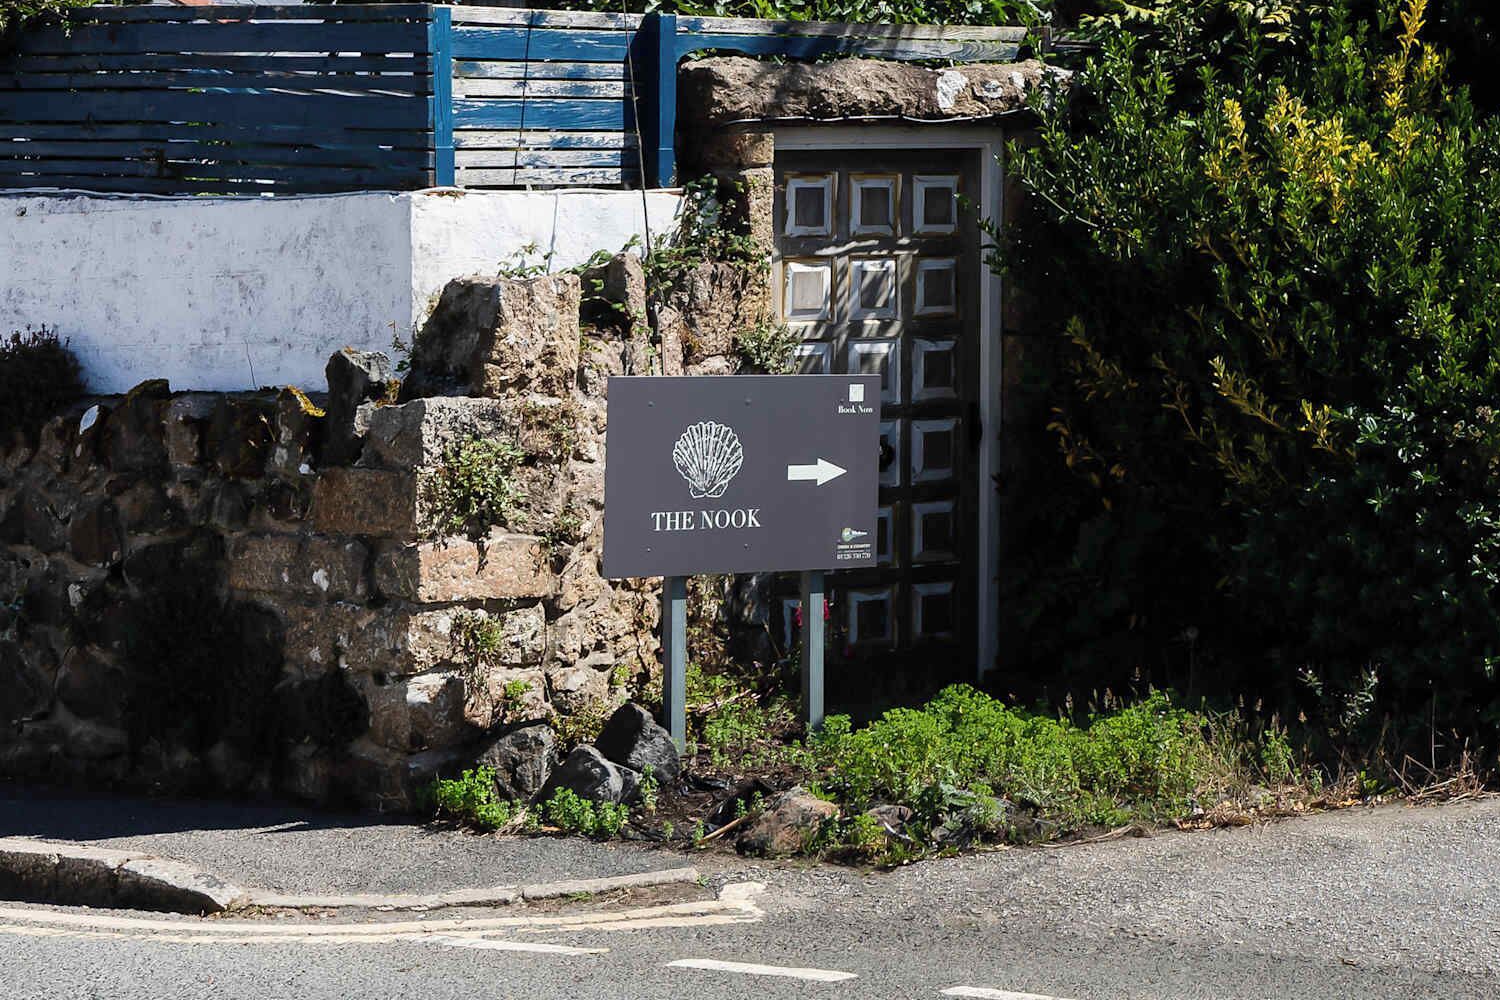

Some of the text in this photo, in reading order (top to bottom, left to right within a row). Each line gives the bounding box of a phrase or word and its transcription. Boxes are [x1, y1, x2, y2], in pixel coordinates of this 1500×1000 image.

[838, 404, 857, 414] Book
[650, 508, 761, 531] THE NOOK
